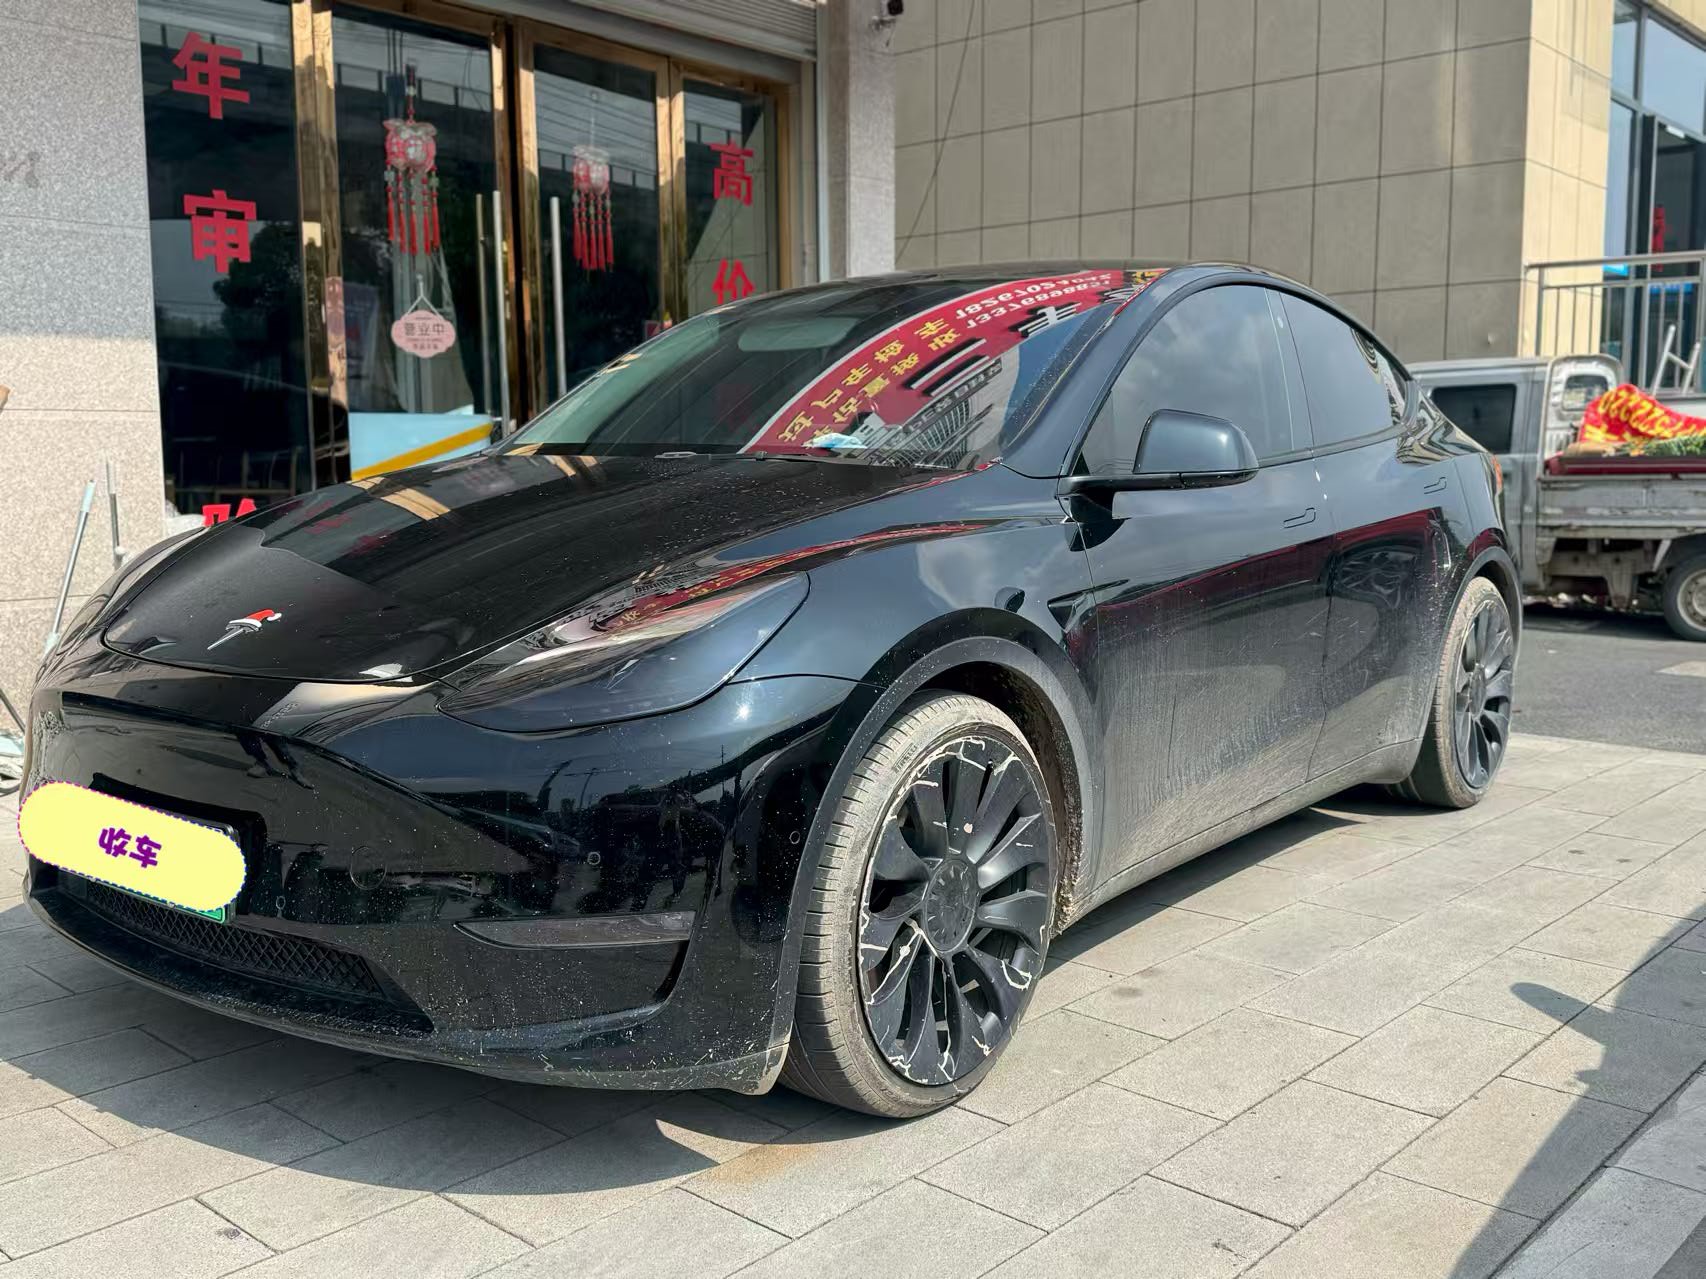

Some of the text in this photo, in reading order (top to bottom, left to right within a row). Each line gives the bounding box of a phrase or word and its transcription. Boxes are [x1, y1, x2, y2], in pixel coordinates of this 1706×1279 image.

[172, 31, 257, 273] 年审
[706, 138, 755, 304] 高价
[404, 322, 445, 336] 营业中
